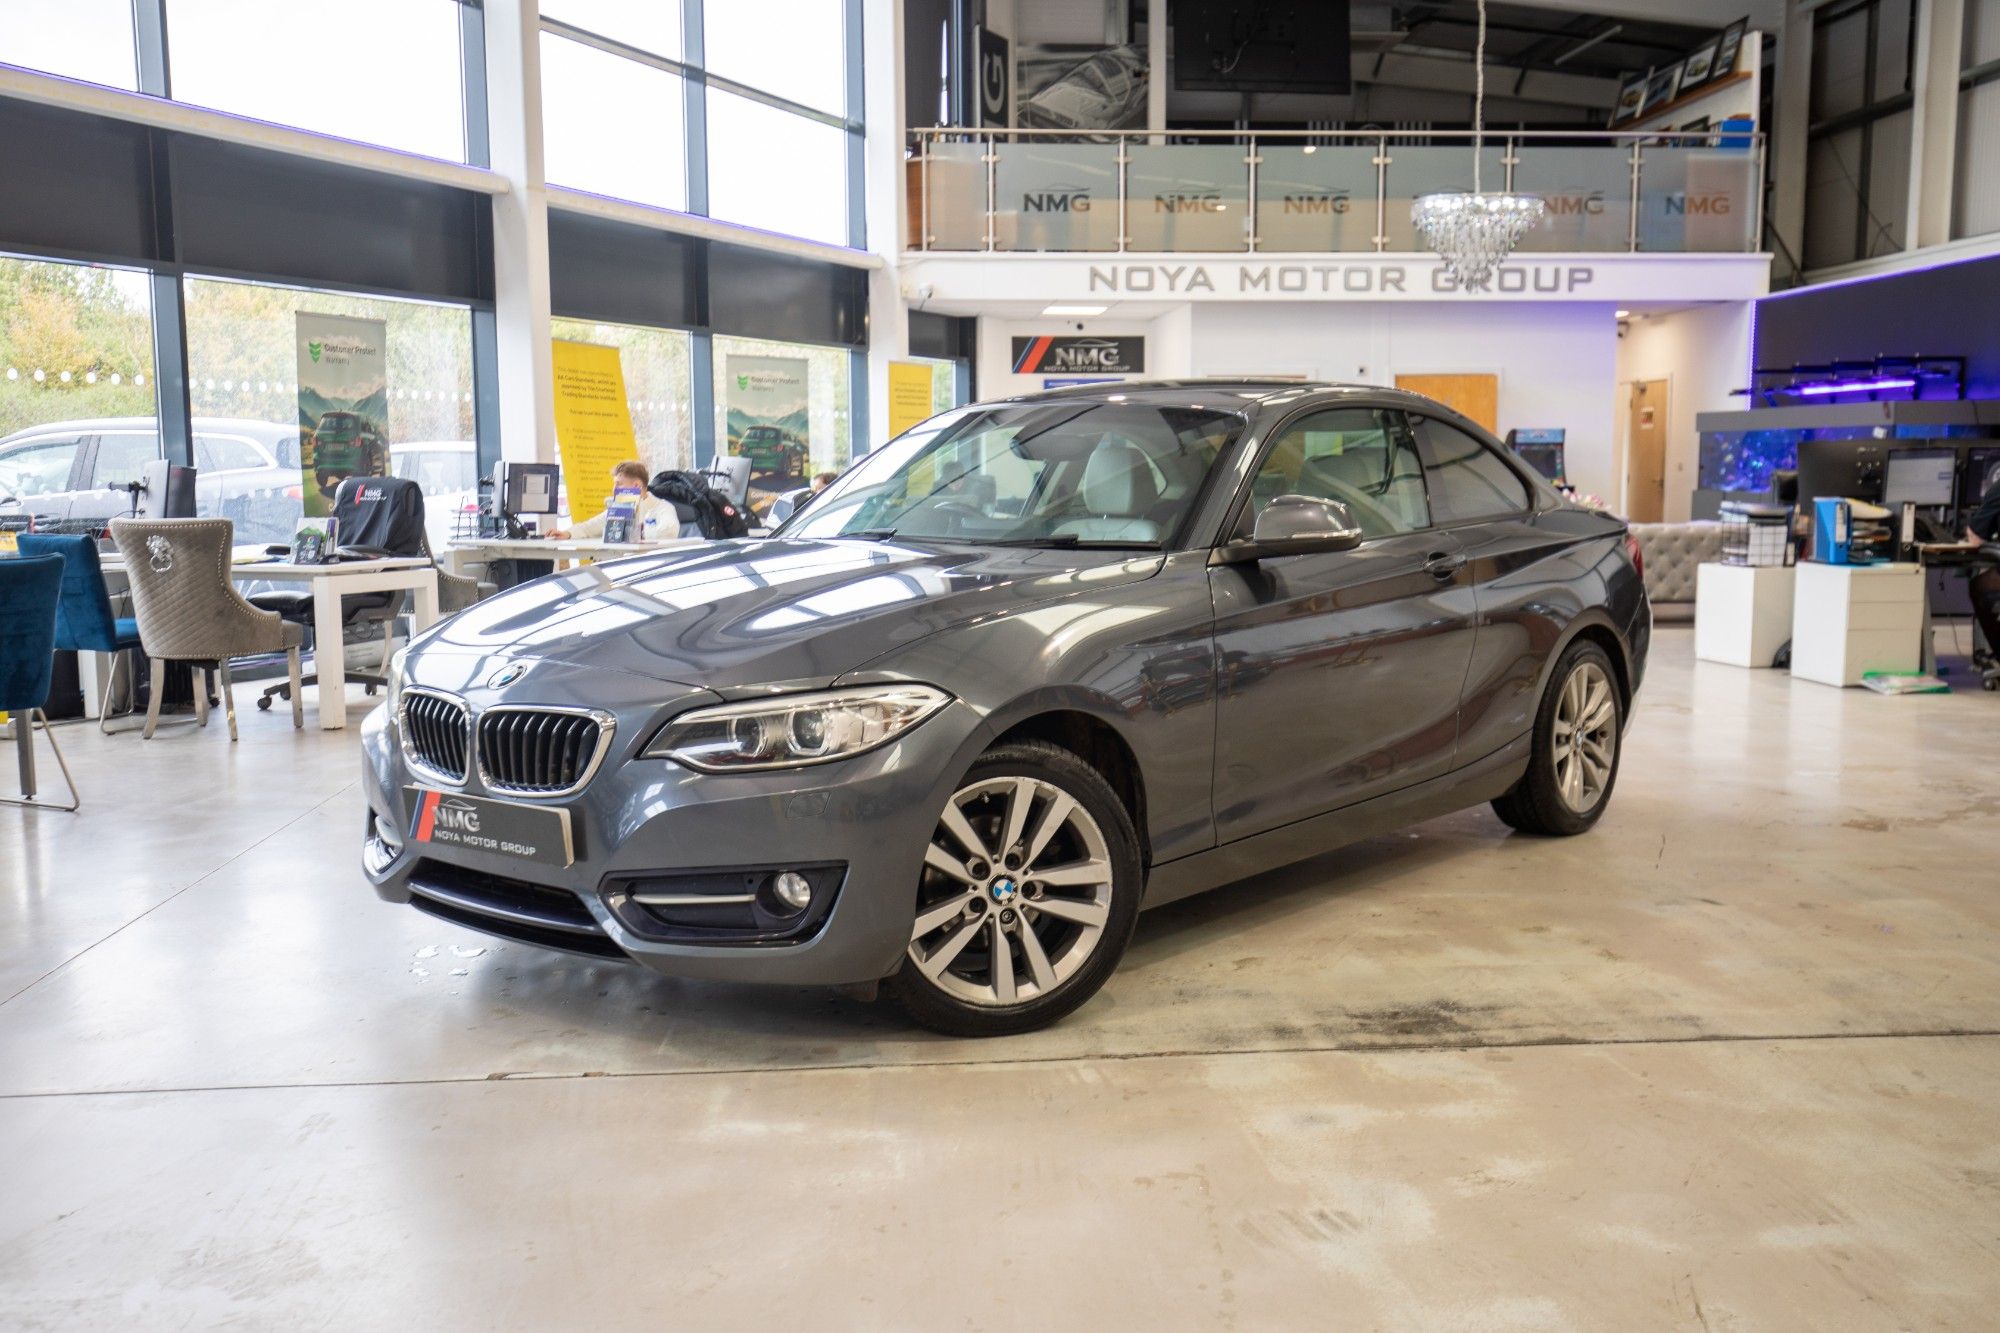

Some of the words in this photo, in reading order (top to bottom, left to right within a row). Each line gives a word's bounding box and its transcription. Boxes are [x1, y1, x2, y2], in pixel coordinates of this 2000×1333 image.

[1023, 193, 1091, 213] NMG
[1155, 195, 1221, 214] NMG
[1283, 194, 1350, 214] NMG
[1665, 196, 1730, 215] NMG
[1089, 266, 1215, 292] NOYA
[1240, 266, 1406, 292] MOTOR
[1055, 347, 1120, 366] NMG
[432, 805, 480, 832] NMG
[434, 829, 460, 842] NOYA
[462, 834, 498, 849] MOTOR
[500, 841, 536, 856] GROUP
